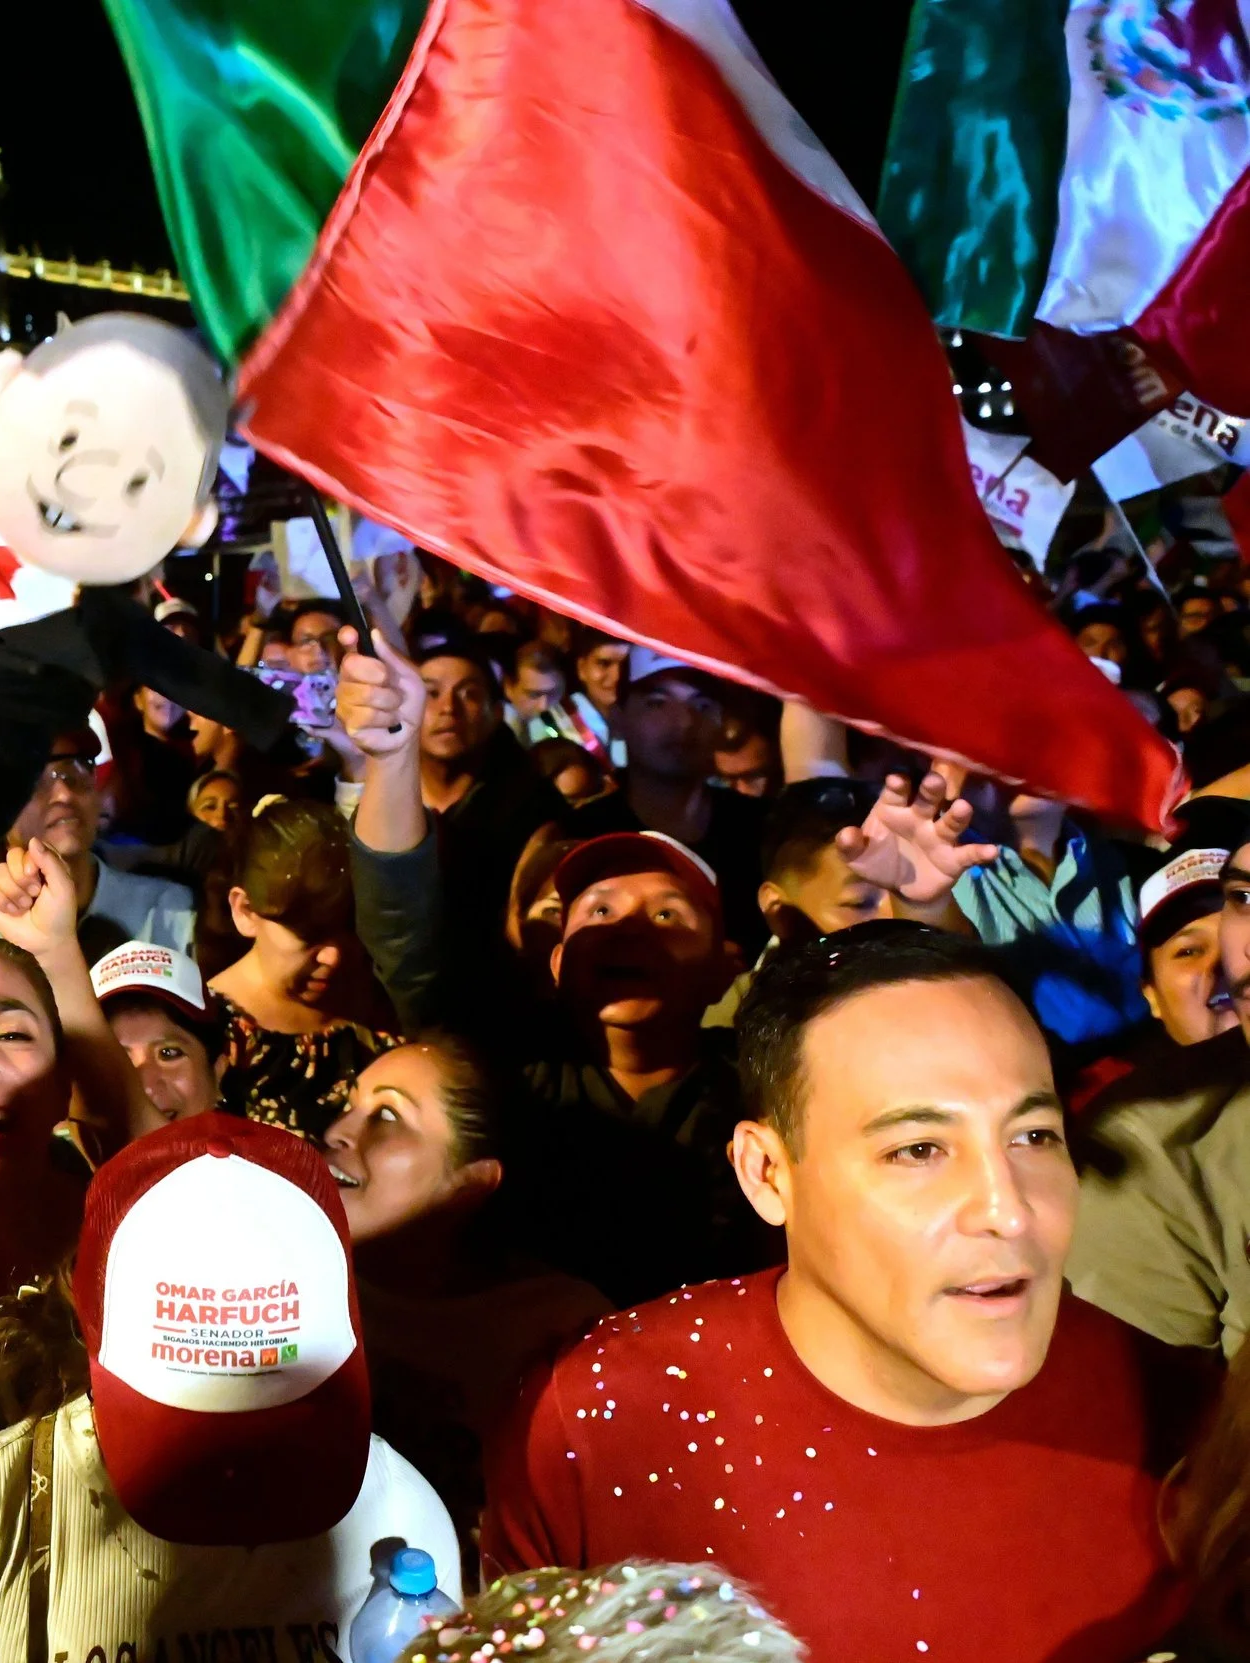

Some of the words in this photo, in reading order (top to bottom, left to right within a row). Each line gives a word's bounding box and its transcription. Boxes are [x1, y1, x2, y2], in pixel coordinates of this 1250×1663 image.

[99, 954, 173, 974] HARFUCH
[155, 1281, 217, 1301] OMAR
[221, 1279, 299, 1302] GARCÍA
[155, 1300, 300, 1325] HARFUCH
[163, 1335, 200, 1345] SIGAMOS
[202, 1339, 248, 1347] HACIENDO
[250, 1337, 288, 1347] HISTORIA
[191, 1328, 264, 1339] SENADOR
[151, 1342, 256, 1368] morena
